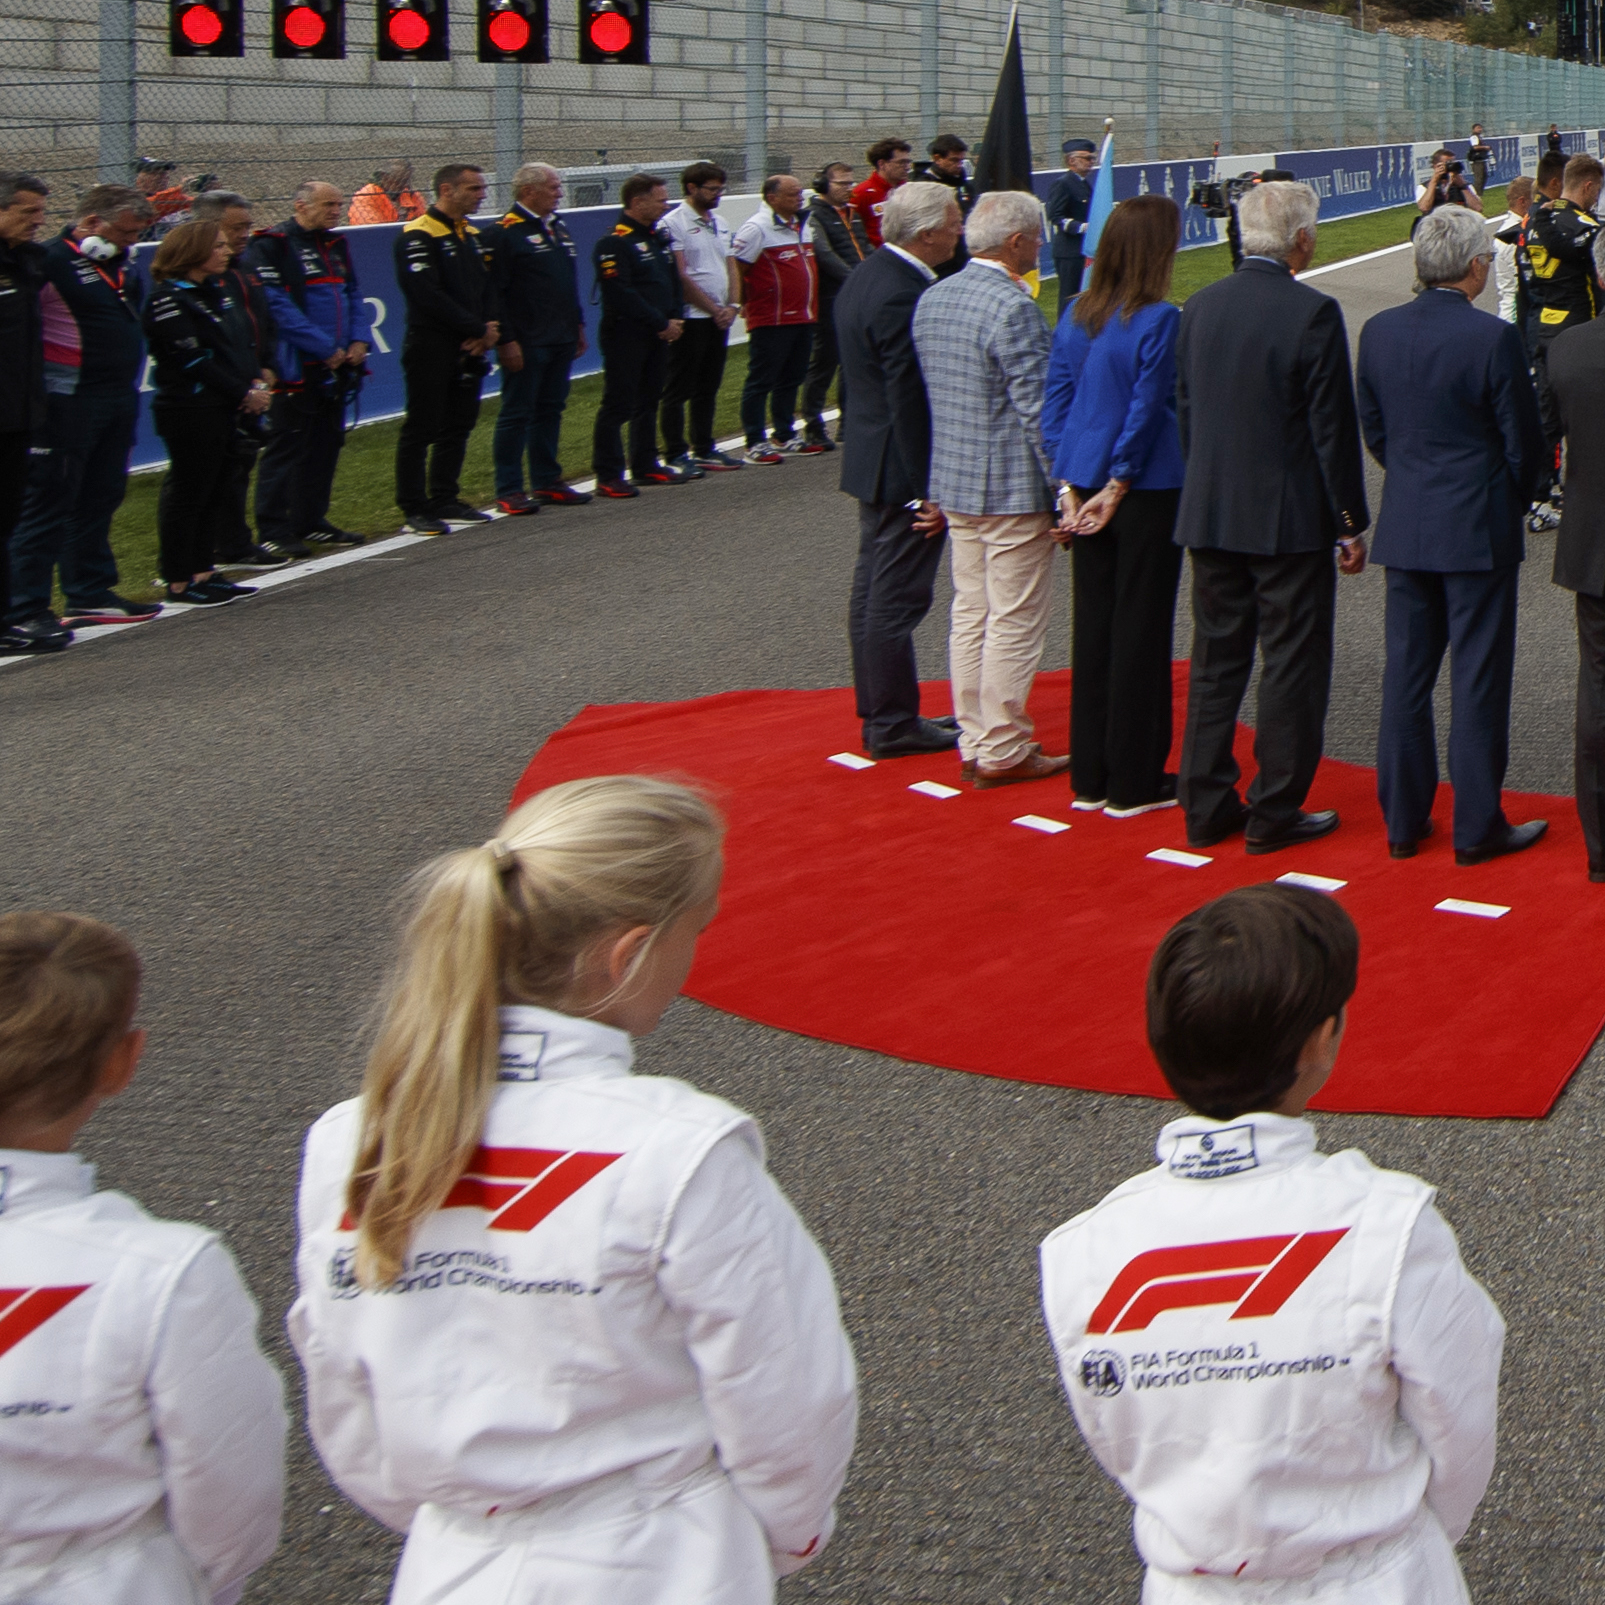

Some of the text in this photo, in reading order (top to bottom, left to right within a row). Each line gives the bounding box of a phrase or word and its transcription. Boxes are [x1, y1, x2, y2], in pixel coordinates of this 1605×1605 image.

[1131, 1352, 1160, 1371] FIA
[1165, 1343, 1247, 1368] Formula
[1131, 1354, 1335, 1391] World Championship
